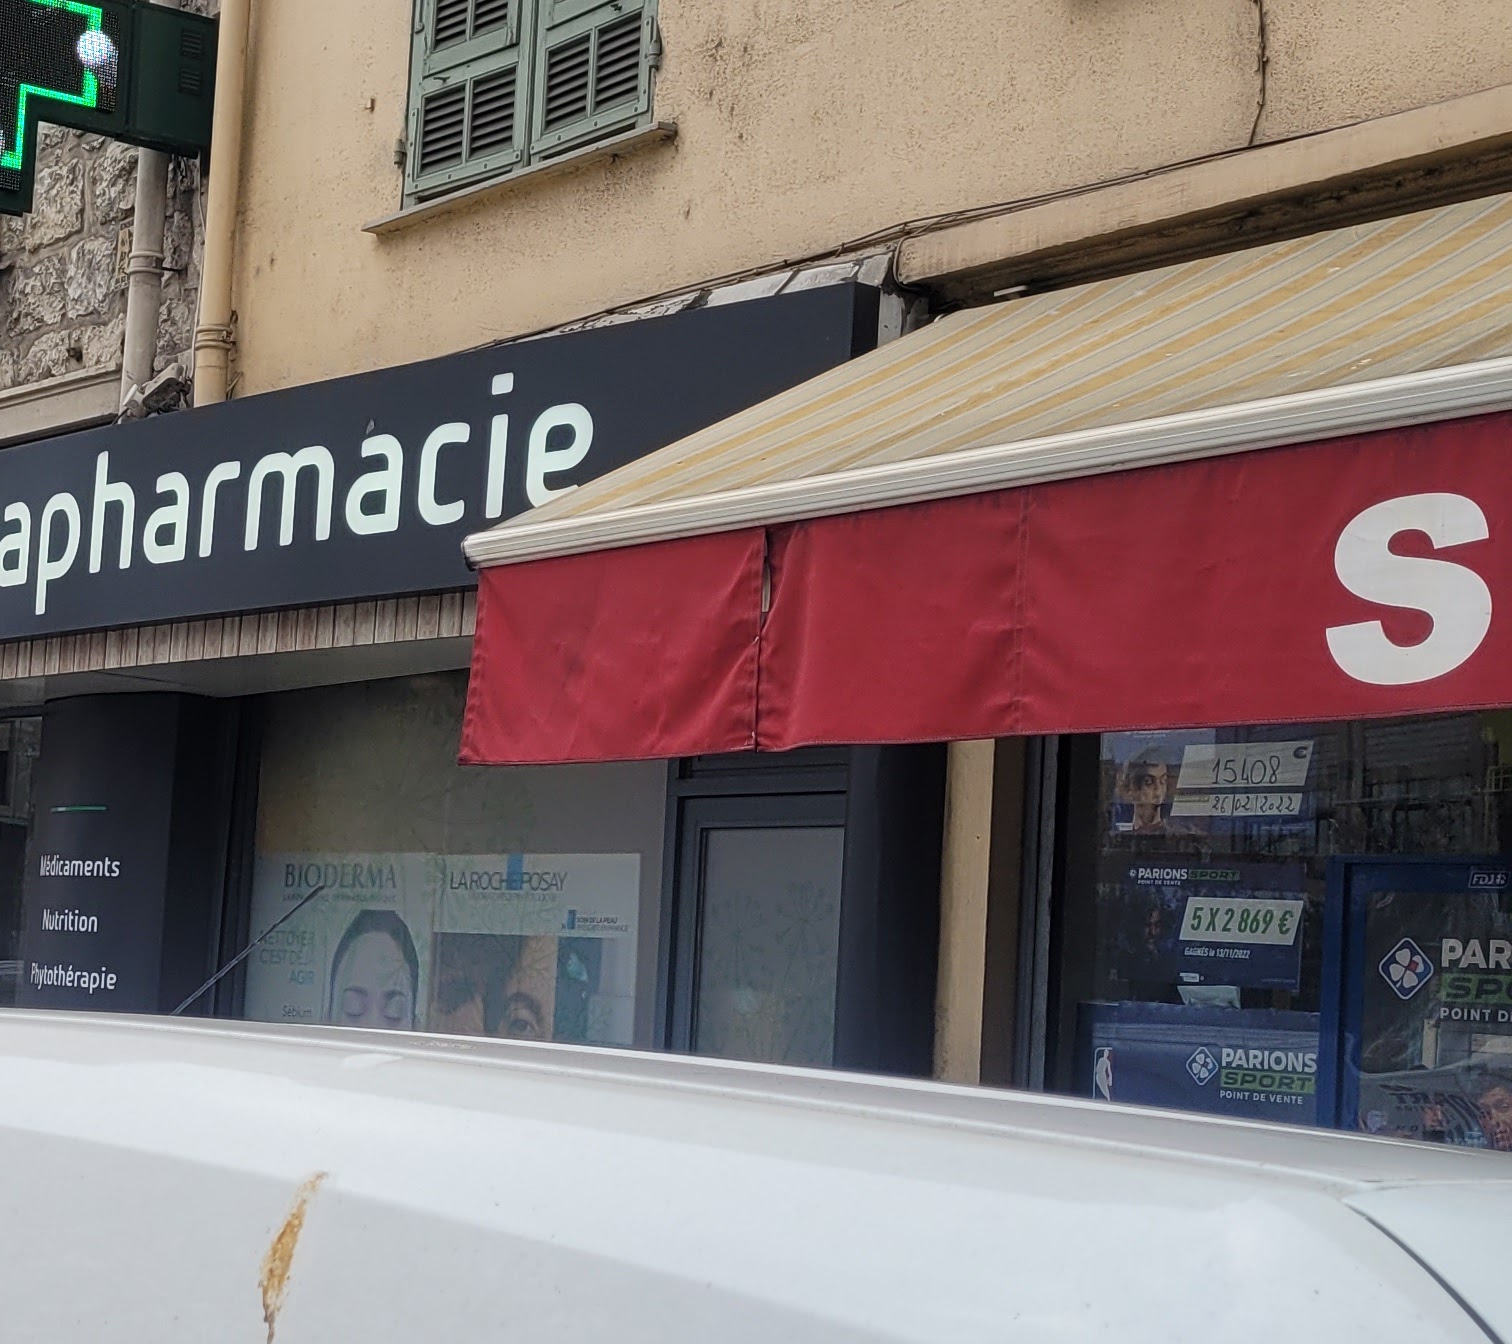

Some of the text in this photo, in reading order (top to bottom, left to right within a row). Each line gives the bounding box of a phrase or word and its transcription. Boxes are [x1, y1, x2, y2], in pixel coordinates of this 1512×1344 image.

[1325, 492, 1493, 685] S
[39, 854, 121, 878] Médicaments
[284, 863, 397, 889] BIODERMA
[1138, 867, 1239, 881] PARIONS SPORT
[450, 871, 468, 890] LA
[1472, 873, 1495, 885] FDJ
[41, 908, 99, 933] Nutrition
[30, 962, 118, 995] Phytothérapie
[1445, 976, 1512, 1000] SP
[1439, 1007, 1492, 1023] POINT
[1221, 1047, 1317, 1074] PARIONS
[1222, 1070, 1313, 1092] SPORT
[1219, 1090, 1304, 1105] POINT DE VENTE
